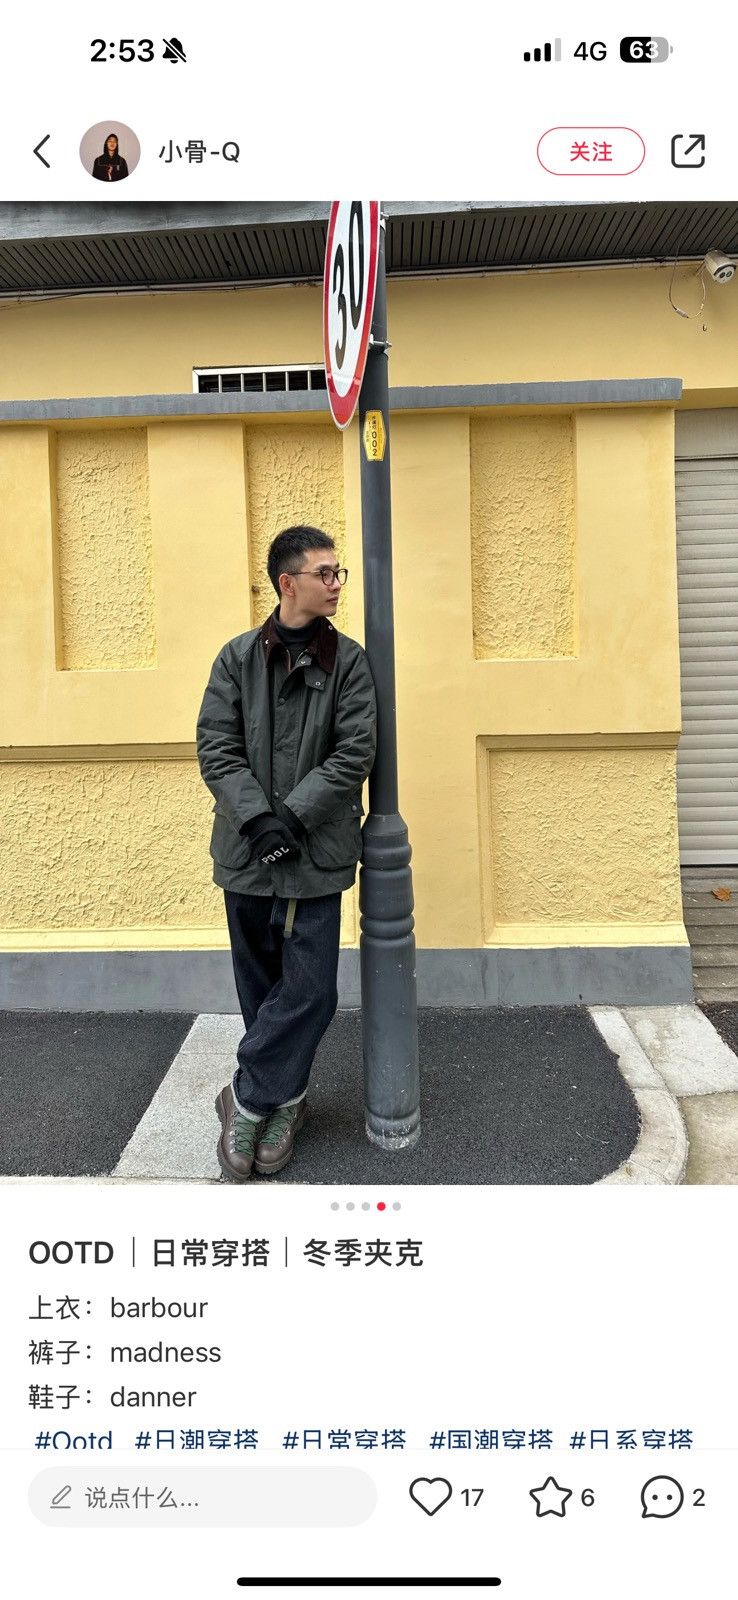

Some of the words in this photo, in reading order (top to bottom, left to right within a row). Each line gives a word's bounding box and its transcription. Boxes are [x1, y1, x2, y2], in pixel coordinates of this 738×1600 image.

[90, 38, 155, 63] 2:53
[573, 40, 608, 62] 4G
[629, 40, 660, 60] 63
[158, 139, 241, 164] 小骨-Q
[569, 140, 613, 162] 关注
[332, 201, 365, 370] 30
[28, 1240, 115, 1265] OOTD
[111, 1296, 209, 1319] barbour
[110, 1340, 222, 1363] madness
[110, 1385, 198, 1408] danner
[460, 1488, 485, 1507] 17
[580, 1487, 595, 1508] 6
[692, 1487, 706, 1507] 2
